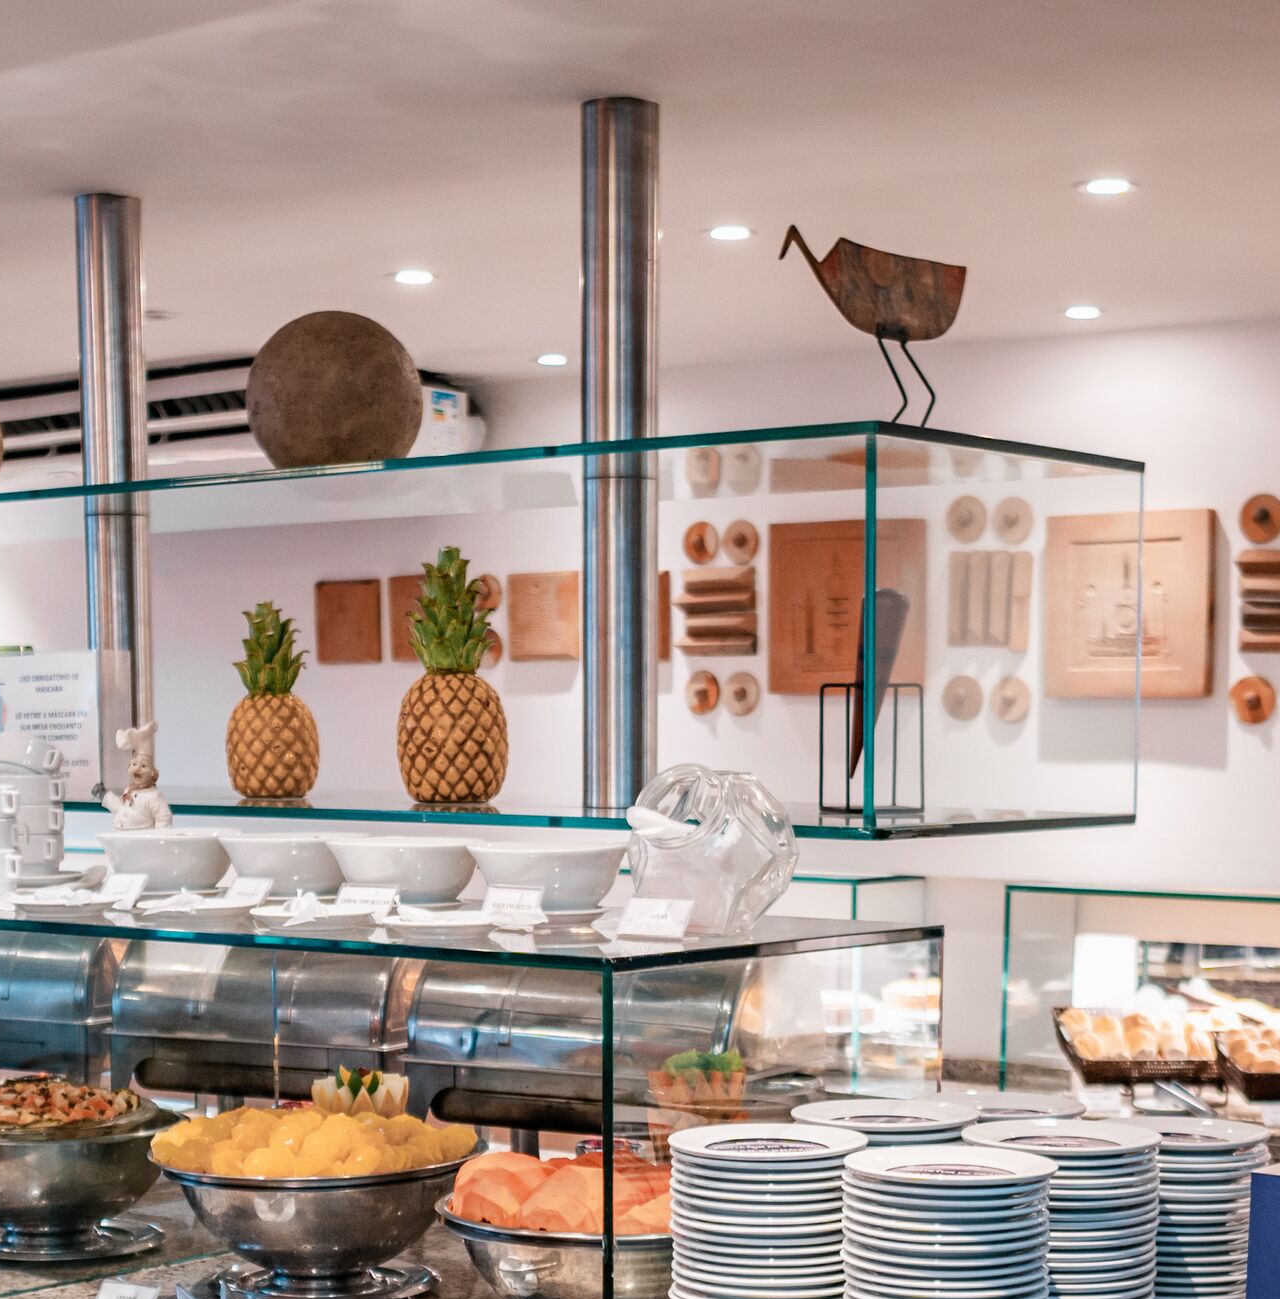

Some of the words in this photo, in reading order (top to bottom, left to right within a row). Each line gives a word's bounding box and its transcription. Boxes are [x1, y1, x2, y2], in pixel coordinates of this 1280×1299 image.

[32, 673, 71, 682] OBRIGATÓRIO
[71, 673, 80, 681] DE
[35, 685, 63, 693] MÁSCARA
[48, 710, 76, 719] MÁSCARA
